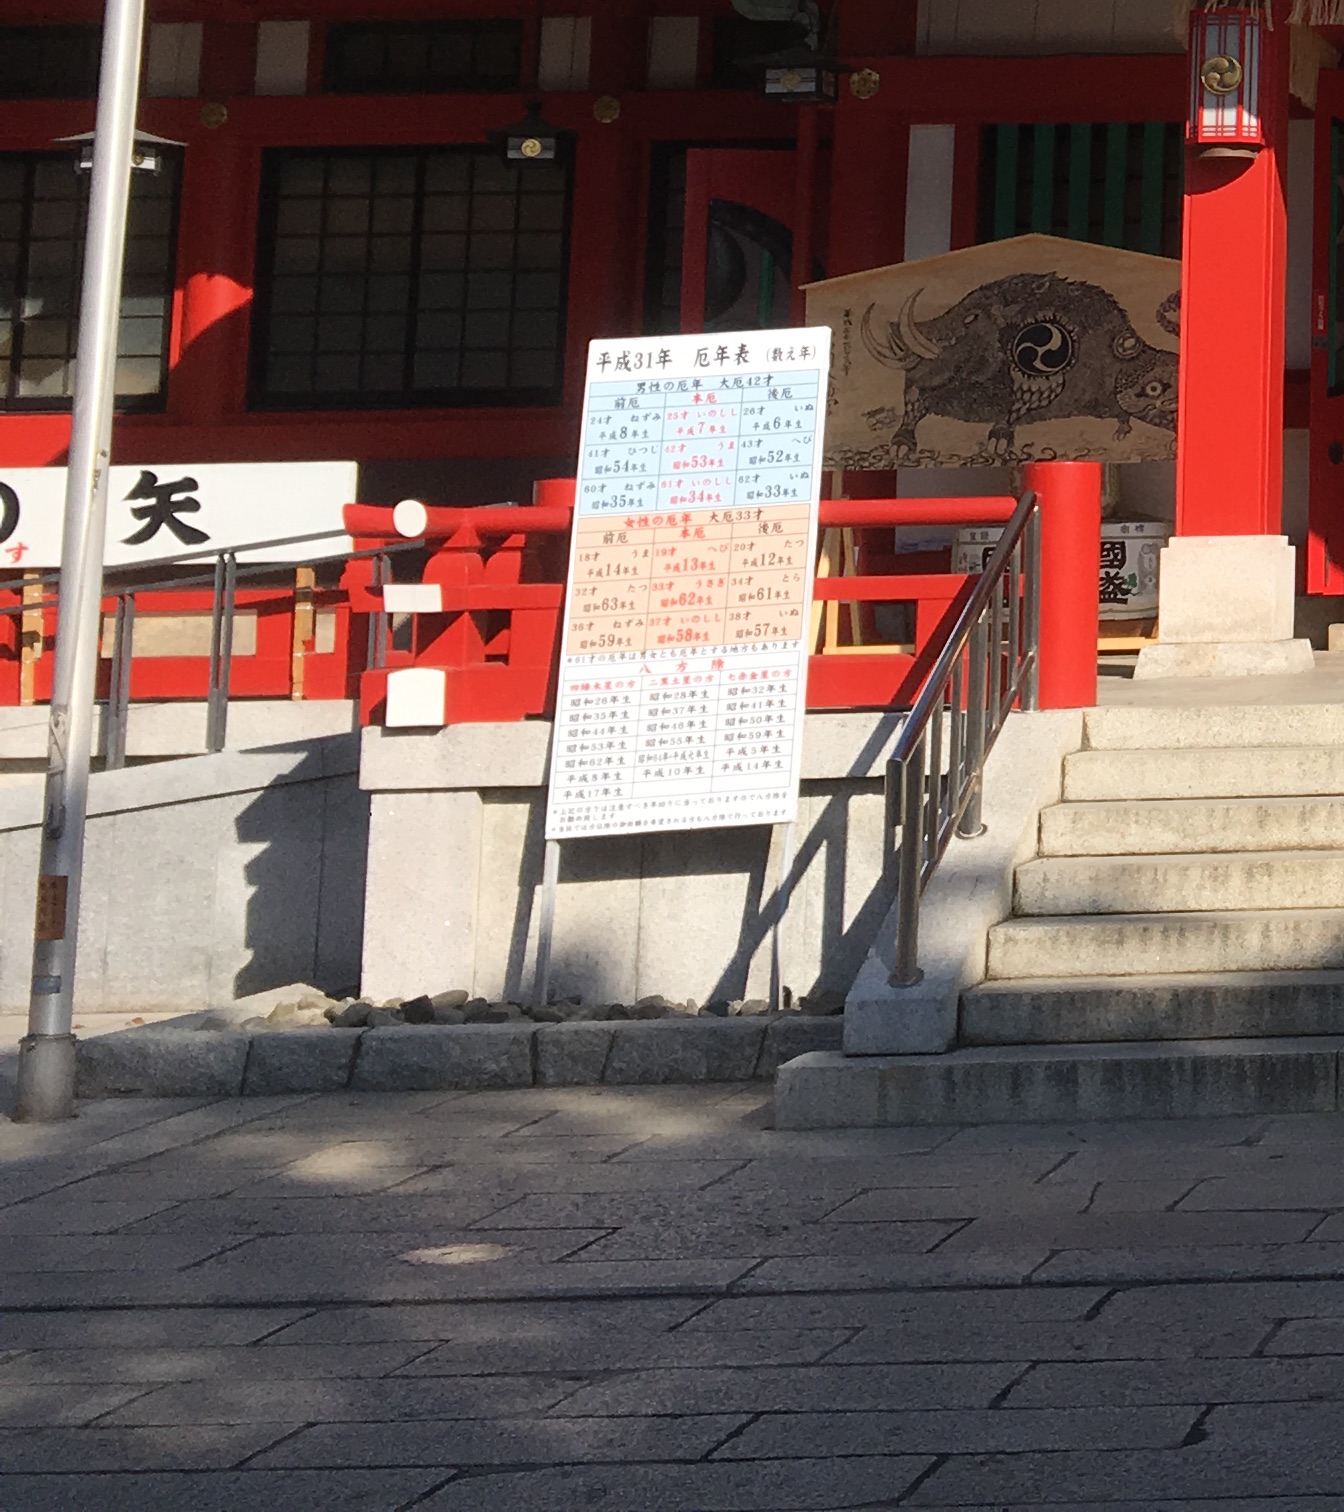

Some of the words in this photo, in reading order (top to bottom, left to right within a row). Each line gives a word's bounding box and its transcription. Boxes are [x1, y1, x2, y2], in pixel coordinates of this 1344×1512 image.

[596, 349, 672, 373] 平成31年
[693, 343, 750, 368] 厄年表
[766, 345, 817, 363] (数え年)
[636, 379, 703, 393] 男性の厄年
[720, 374, 774, 388] 大厄42才
[692, 393, 718, 404] 本厄
[768, 388, 792, 399] 後厄
[614, 398, 640, 409] 前厄
[743, 406, 766, 415] 26才
[794, 404, 814, 412] いぬ
[590, 415, 612, 425] 24才
[630, 414, 662, 422] ねずみ
[667, 411, 688, 420] 25才
[697, 408, 737, 417] いのしし
[676, 422, 727, 435] 平成7年生
[752, 417, 803, 431] 平成6年生
[599, 427, 649, 440] 平成8年生
[664, 443, 686, 453] 42才
[717, 441, 735, 450] うま
[741, 439, 763, 448] 43才
[791, 436, 812, 444] へび
[588, 448, 610, 458] 41才
[628, 445, 658, 456] ひつじ
[749, 450, 801, 464] 昭和52年生
[595, 460, 647, 474] 昭和54年生
[673, 456, 724, 469] 昭和53年生
[661, 478, 683, 488] 61才
[692, 477, 732, 486] いのしし
[738, 474, 761, 483] 62才
[789, 472, 809, 480] いぬ
[584, 484, 607, 493] 60才
[625, 482, 655, 491] ねずみ
[746, 486, 798, 500] 昭和33年生
[592, 495, 644, 509] 昭和35年生
[670, 490, 721, 504] 昭和34年生
[624, 514, 692, 528] 女性の厄年
[709, 508, 764, 524] 大厄33才
[679, 528, 706, 539] 本厄
[758, 522, 783, 534] 後厄
[603, 532, 629, 544] 前厄
[655, 547, 677, 557] 19才
[707, 544, 729, 553] へび
[733, 542, 755, 552] 20才
[784, 540, 804, 548] たつ
[578, 552, 600, 562] 18才
[632, 549, 649, 559] うま
[741, 553, 794, 567] 平成12年生
[586, 564, 639, 578] 平成14年生
[664, 558, 716, 573] 平成13年生
[652, 582, 674, 591] 33才
[695, 578, 725, 588] うさぎ
[731, 576, 753, 586] 34才
[782, 574, 800, 583] とら
[575, 586, 598, 596] 32才
[627, 583, 647, 593] たつ
[738, 588, 790, 602] 昭和61年生
[583, 598, 636, 612] 昭和63年生
[660, 593, 713, 607] 昭和62年生
[649, 617, 671, 626] 37才
[680, 614, 721, 624] いのしし
[729, 611, 751, 621] 38才
[779, 609, 799, 617] いぬ
[572, 621, 595, 631] 36才
[613, 619, 644, 628] ねずみ
[735, 624, 788, 638] 昭和57年生
[580, 635, 632, 649] 昭和59年生
[657, 629, 710, 644] 昭和58年生
[650, 690, 709, 701] 昭和28年生
[727, 684, 788, 696] 昭和32年生
[571, 695, 631, 707] 昭和26年生
[726, 699, 787, 711] 昭和41年生
[569, 710, 630, 722] 昭和35年生
[648, 705, 708, 716] 昭和37年生
[647, 720, 707, 732] 昭和46年生
[725, 714, 785, 726] 昭和50年生
[568, 726, 628, 737] 昭和44年生
[724, 730, 785, 741] 昭和59年生
[566, 741, 627, 752] 昭和53年生
[645, 736, 706, 747] 昭和55年生
[725, 745, 782, 756] 平成5年生
[565, 757, 626, 768] 昭和62年生
[721, 760, 784, 772] 平成14年生
[566, 772, 623, 784] 平成8年生
[642, 766, 705, 778] 平成10年生
[563, 788, 624, 799] 平成17年生
